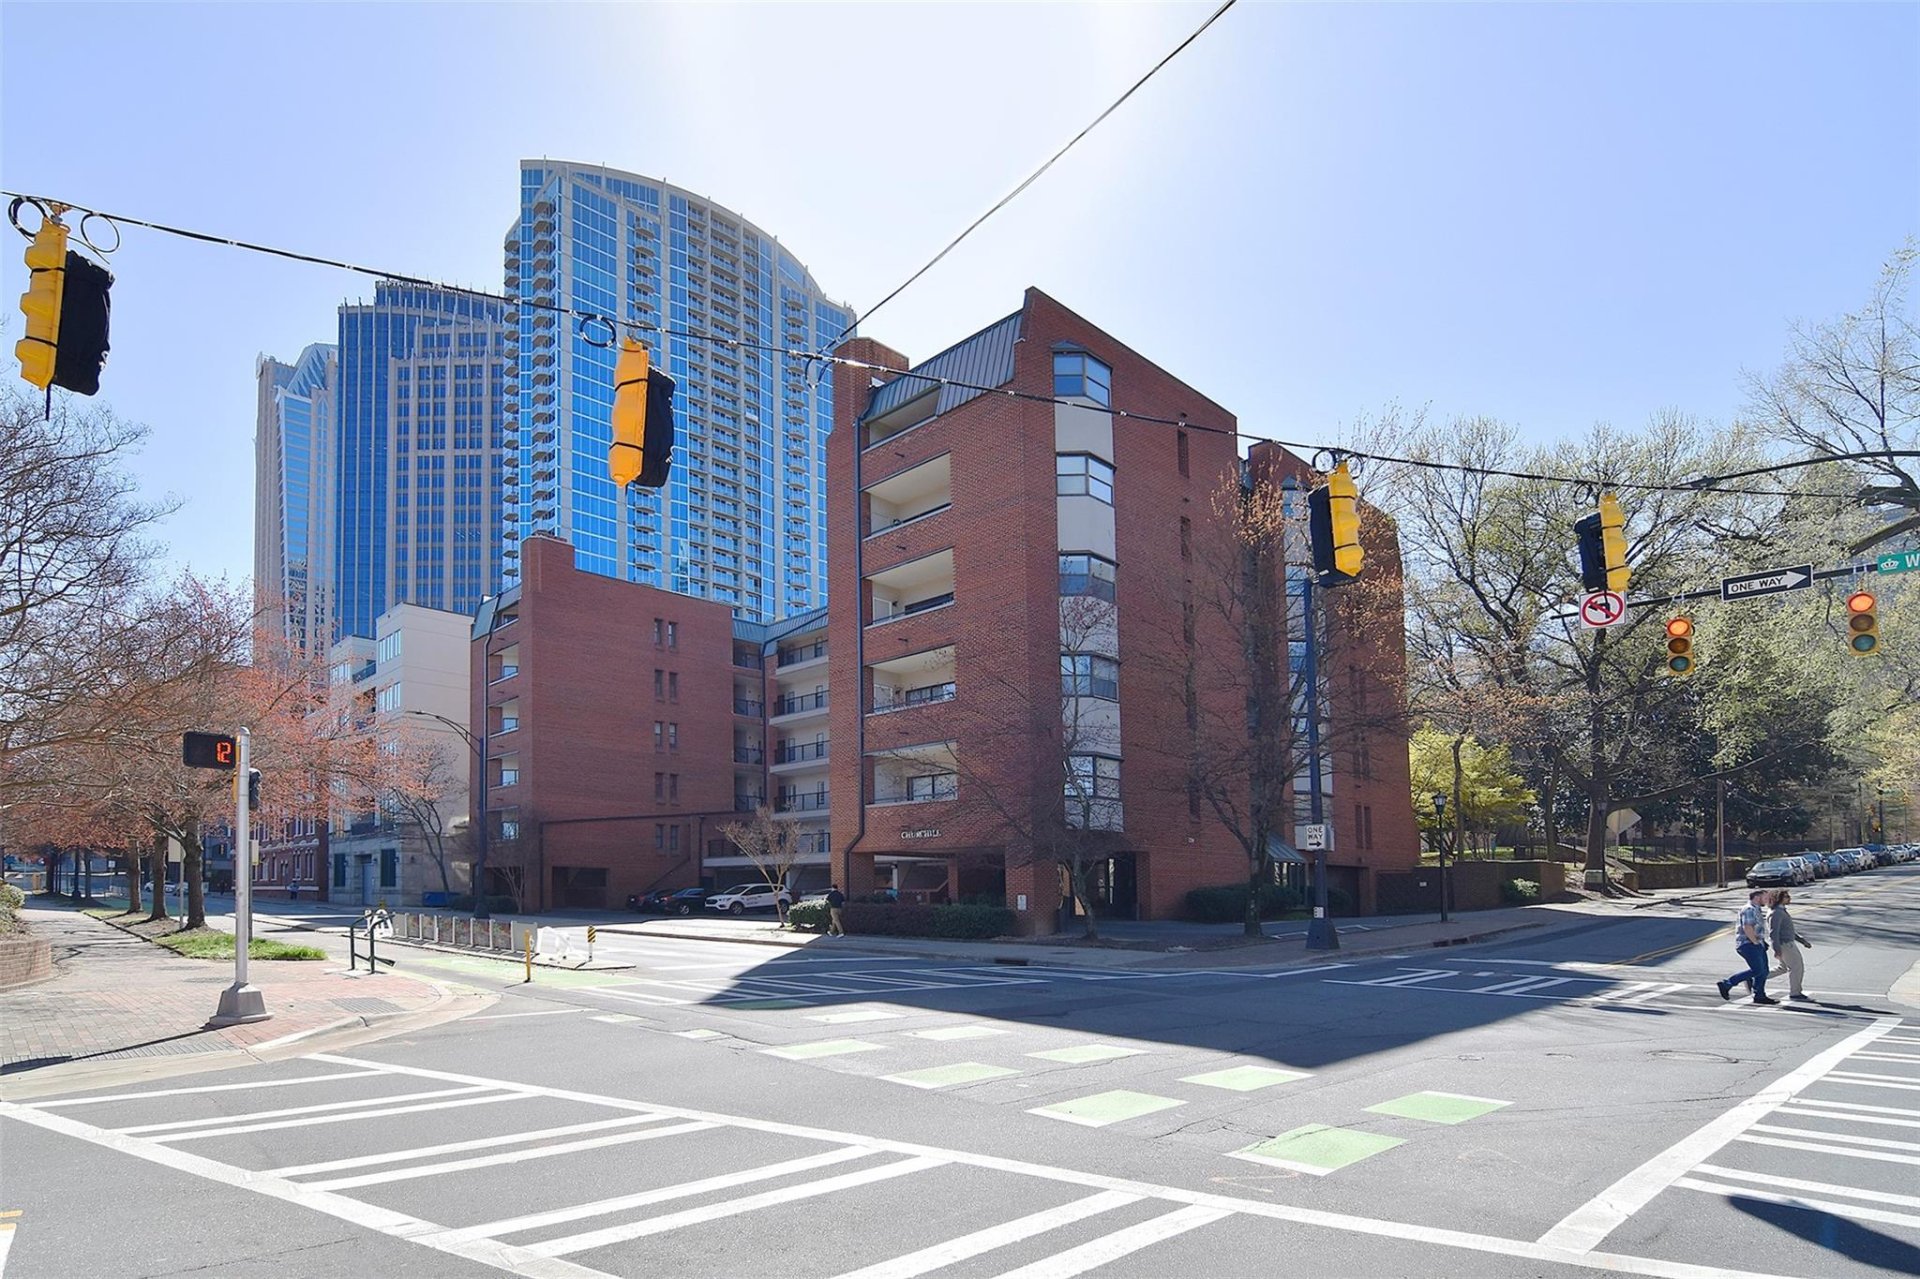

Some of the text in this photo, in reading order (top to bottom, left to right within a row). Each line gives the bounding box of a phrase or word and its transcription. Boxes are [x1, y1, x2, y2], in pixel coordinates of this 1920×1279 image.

[1904, 553, 1920, 568] W
[1731, 577, 1783, 592] ONE WAY
[216, 742, 231, 763] 12
[1307, 826, 1323, 834] ONE
